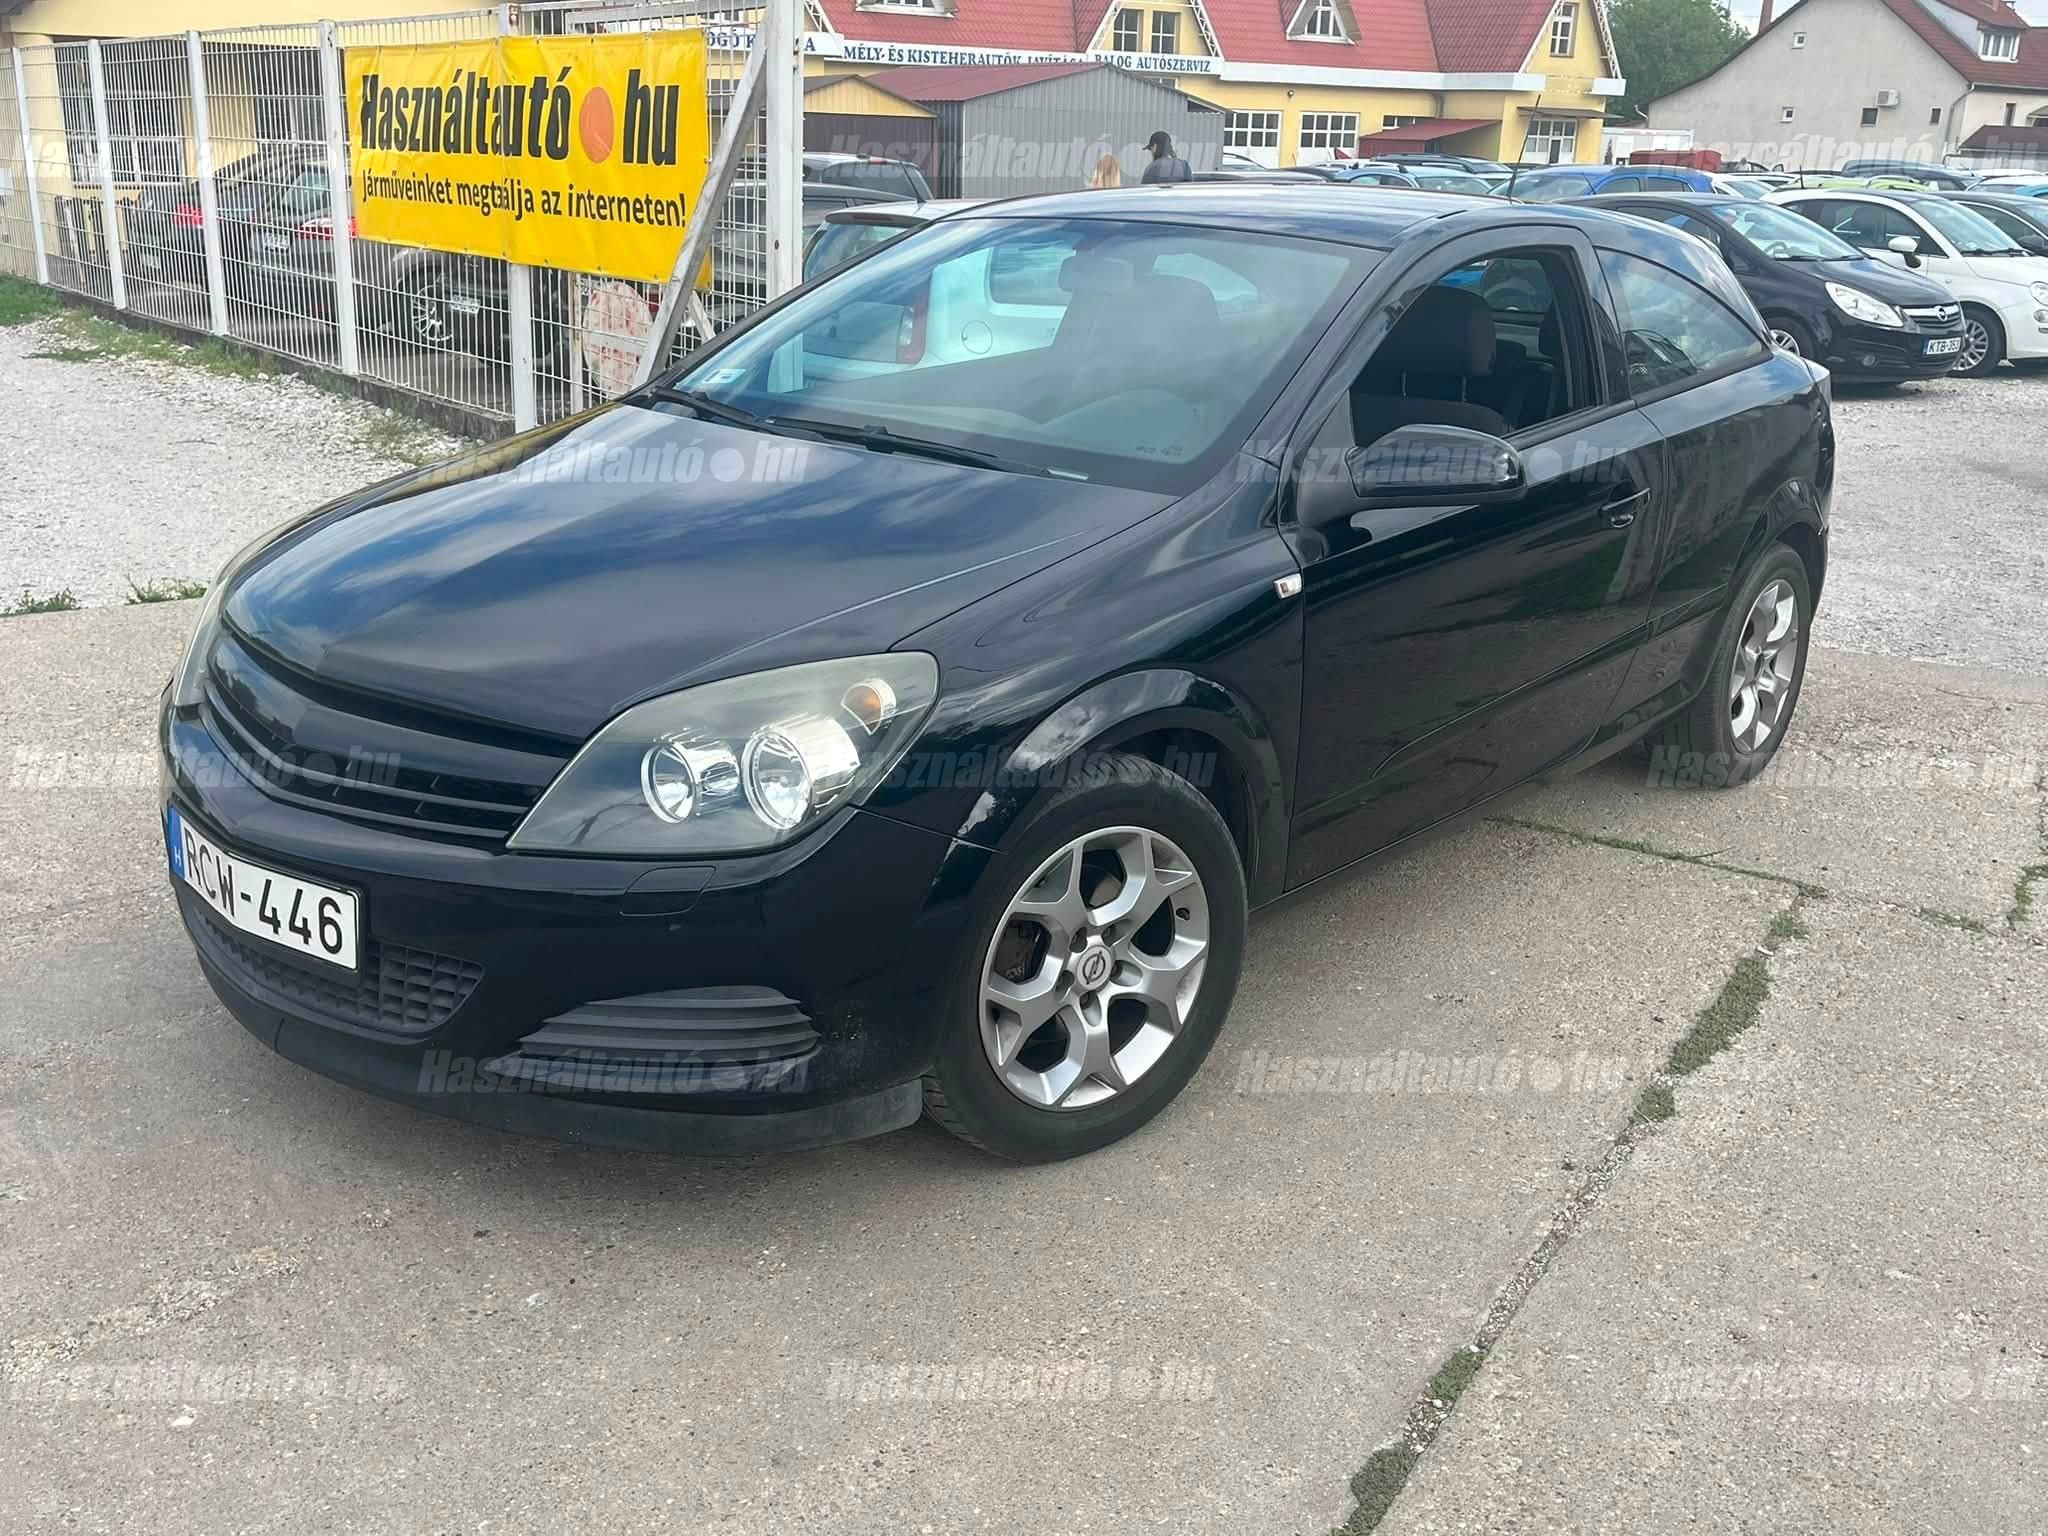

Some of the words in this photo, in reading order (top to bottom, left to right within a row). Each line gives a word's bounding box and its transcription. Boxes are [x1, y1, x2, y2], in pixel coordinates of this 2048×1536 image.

[887, 45, 904, 62] ÉS
[1136, 54, 1211, 72] AUTÓSZERVIZ
[362, 168, 453, 205] Járműveinket
[541, 189, 562, 215] az
[568, 184, 686, 228] interneten!
[183, 826, 343, 955] RCW-446
